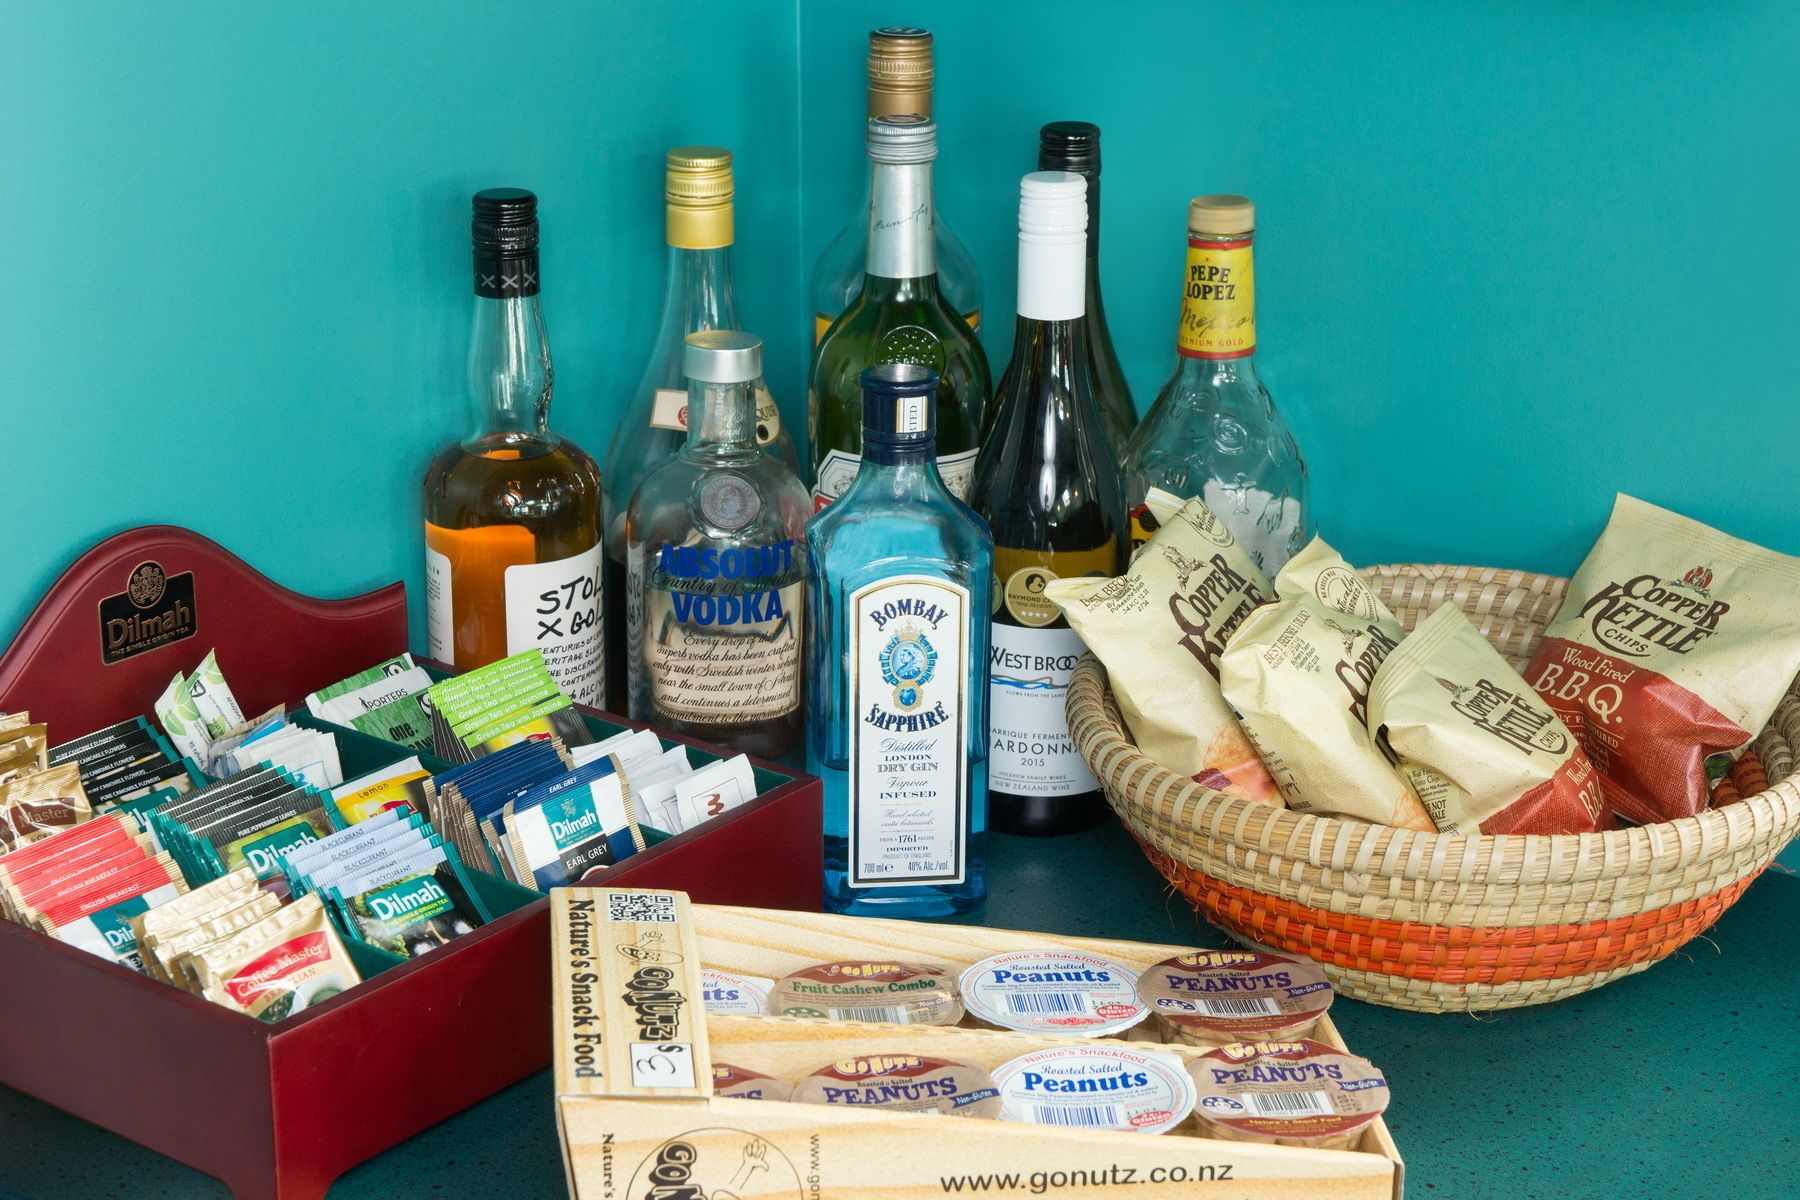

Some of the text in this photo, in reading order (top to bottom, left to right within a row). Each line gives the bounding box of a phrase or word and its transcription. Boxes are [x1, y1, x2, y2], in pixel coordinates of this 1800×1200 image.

[1190, 264, 1230, 283] PEPE
[1186, 281, 1236, 301] LOPEZ
[660, 539, 795, 580] ABSOLUT
[651, 566, 717, 597] Country
[1008, 593, 1041, 603] RAYMOND
[1168, 553, 1248, 635] COPPER
[1622, 574, 1731, 631] COPPER
[671, 588, 784, 626] VODKA
[869, 598, 949, 632] BOMBAY
[1578, 581, 1718, 655] KETTLE
[106, 600, 190, 649] Dilmah
[537, 617, 564, 640] X
[656, 641, 796, 661] superb vodka has been crafted
[683, 631, 758, 651] Every drop of
[1603, 628, 1650, 653] CHIPS
[1263, 643, 1282, 665] BEST
[653, 661, 776, 678] only with Swedish winter
[1562, 647, 1636, 684] Wood Fired
[657, 676, 766, 694] near the small town of
[1532, 663, 1623, 724] B.B.Q.
[366, 687, 409, 709] PORTERS
[660, 693, 681, 704] and
[681, 695, 731, 708] continues
[742, 686, 793, 706] determined
[1450, 678, 1514, 722] COPPER
[464, 689, 549, 731] Green Jasmine
[476, 700, 563, 740] Green Tea with Jasmine
[721, 712, 733, 722] to
[733, 710, 750, 722] the
[864, 700, 950, 732] SAPPHIRE
[388, 722, 419, 742] one.
[991, 728, 1028, 739] ARRIQUE
[1473, 694, 1555, 755] KETTLE
[878, 738, 938, 753] Distilled
[993, 739, 1079, 755] ARDONN
[1539, 730, 1561, 749] CHIPS
[80, 742, 127, 765] CAMOMILE FLOWERS
[885, 754, 932, 762] LONDON
[1020, 758, 1045, 767] 2015
[89, 754, 136, 778] CAMOMILE FLOWERS
[877, 762, 938, 773] DRY GIN
[99, 768, 147, 790] CAMOMILE FLOWERS
[100, 774, 161, 801] PURE CAMOMILE FLOWERS
[357, 781, 390, 799] Lemon
[548, 776, 578, 794] EARL GREY
[886, 776, 928, 790] Vapour
[994, 780, 1071, 792] NEW ZEALAND WINE
[879, 791, 937, 800] INFUSED
[1432, 799, 1447, 811] NOT
[237, 809, 297, 838] PURE PEPPERMINT LEAVES
[550, 808, 597, 841] Dilmah
[321, 827, 365, 850] BLACKCURRANT
[330, 837, 376, 861] BLACKCURRANT
[898, 833, 917, 843] 1761
[343, 848, 390, 872] BLACKCURRANT
[566, 843, 608, 870] EARL GREY
[863, 863, 875, 873] 700
[876, 862, 884, 873] ml
[907, 861, 922, 872] 40%
[368, 864, 413, 886] BLACKCURRANT
[106, 884, 140, 902] BREAKFAST
[369, 880, 446, 921] Dilmah
[236, 964, 277, 997] Coffee
[276, 943, 324, 970] Master
[992, 953, 1108, 968] Nature's Snackfood
[1008, 963, 1051, 971] Roasted
[791, 979, 936, 995] Fruit Cashew Combo
[991, 969, 1111, 984] Peanuts
[1166, 971, 1292, 992] PEANUTS
[568, 899, 603, 1079] Nature's Snack Food
[1290, 984, 1325, 997] Non-Gluten
[1023, 1048, 1148, 1065] Nature's Snackfood
[1276, 1060, 1300, 1068] Salted
[1041, 1062, 1124, 1075] Roasted Salted
[1210, 1063, 1344, 1085] PEANUTS
[823, 1077, 958, 1105] PEANUTS
[856, 1078, 914, 1088] Roasted Salted
[1022, 1071, 1149, 1093] Peanuts
[1342, 1080, 1379, 1092] Non-Gluten
[956, 1089, 993, 1105] Non-Gluten
[940, 1164, 1234, 1195] www.gonutz.co.nz
